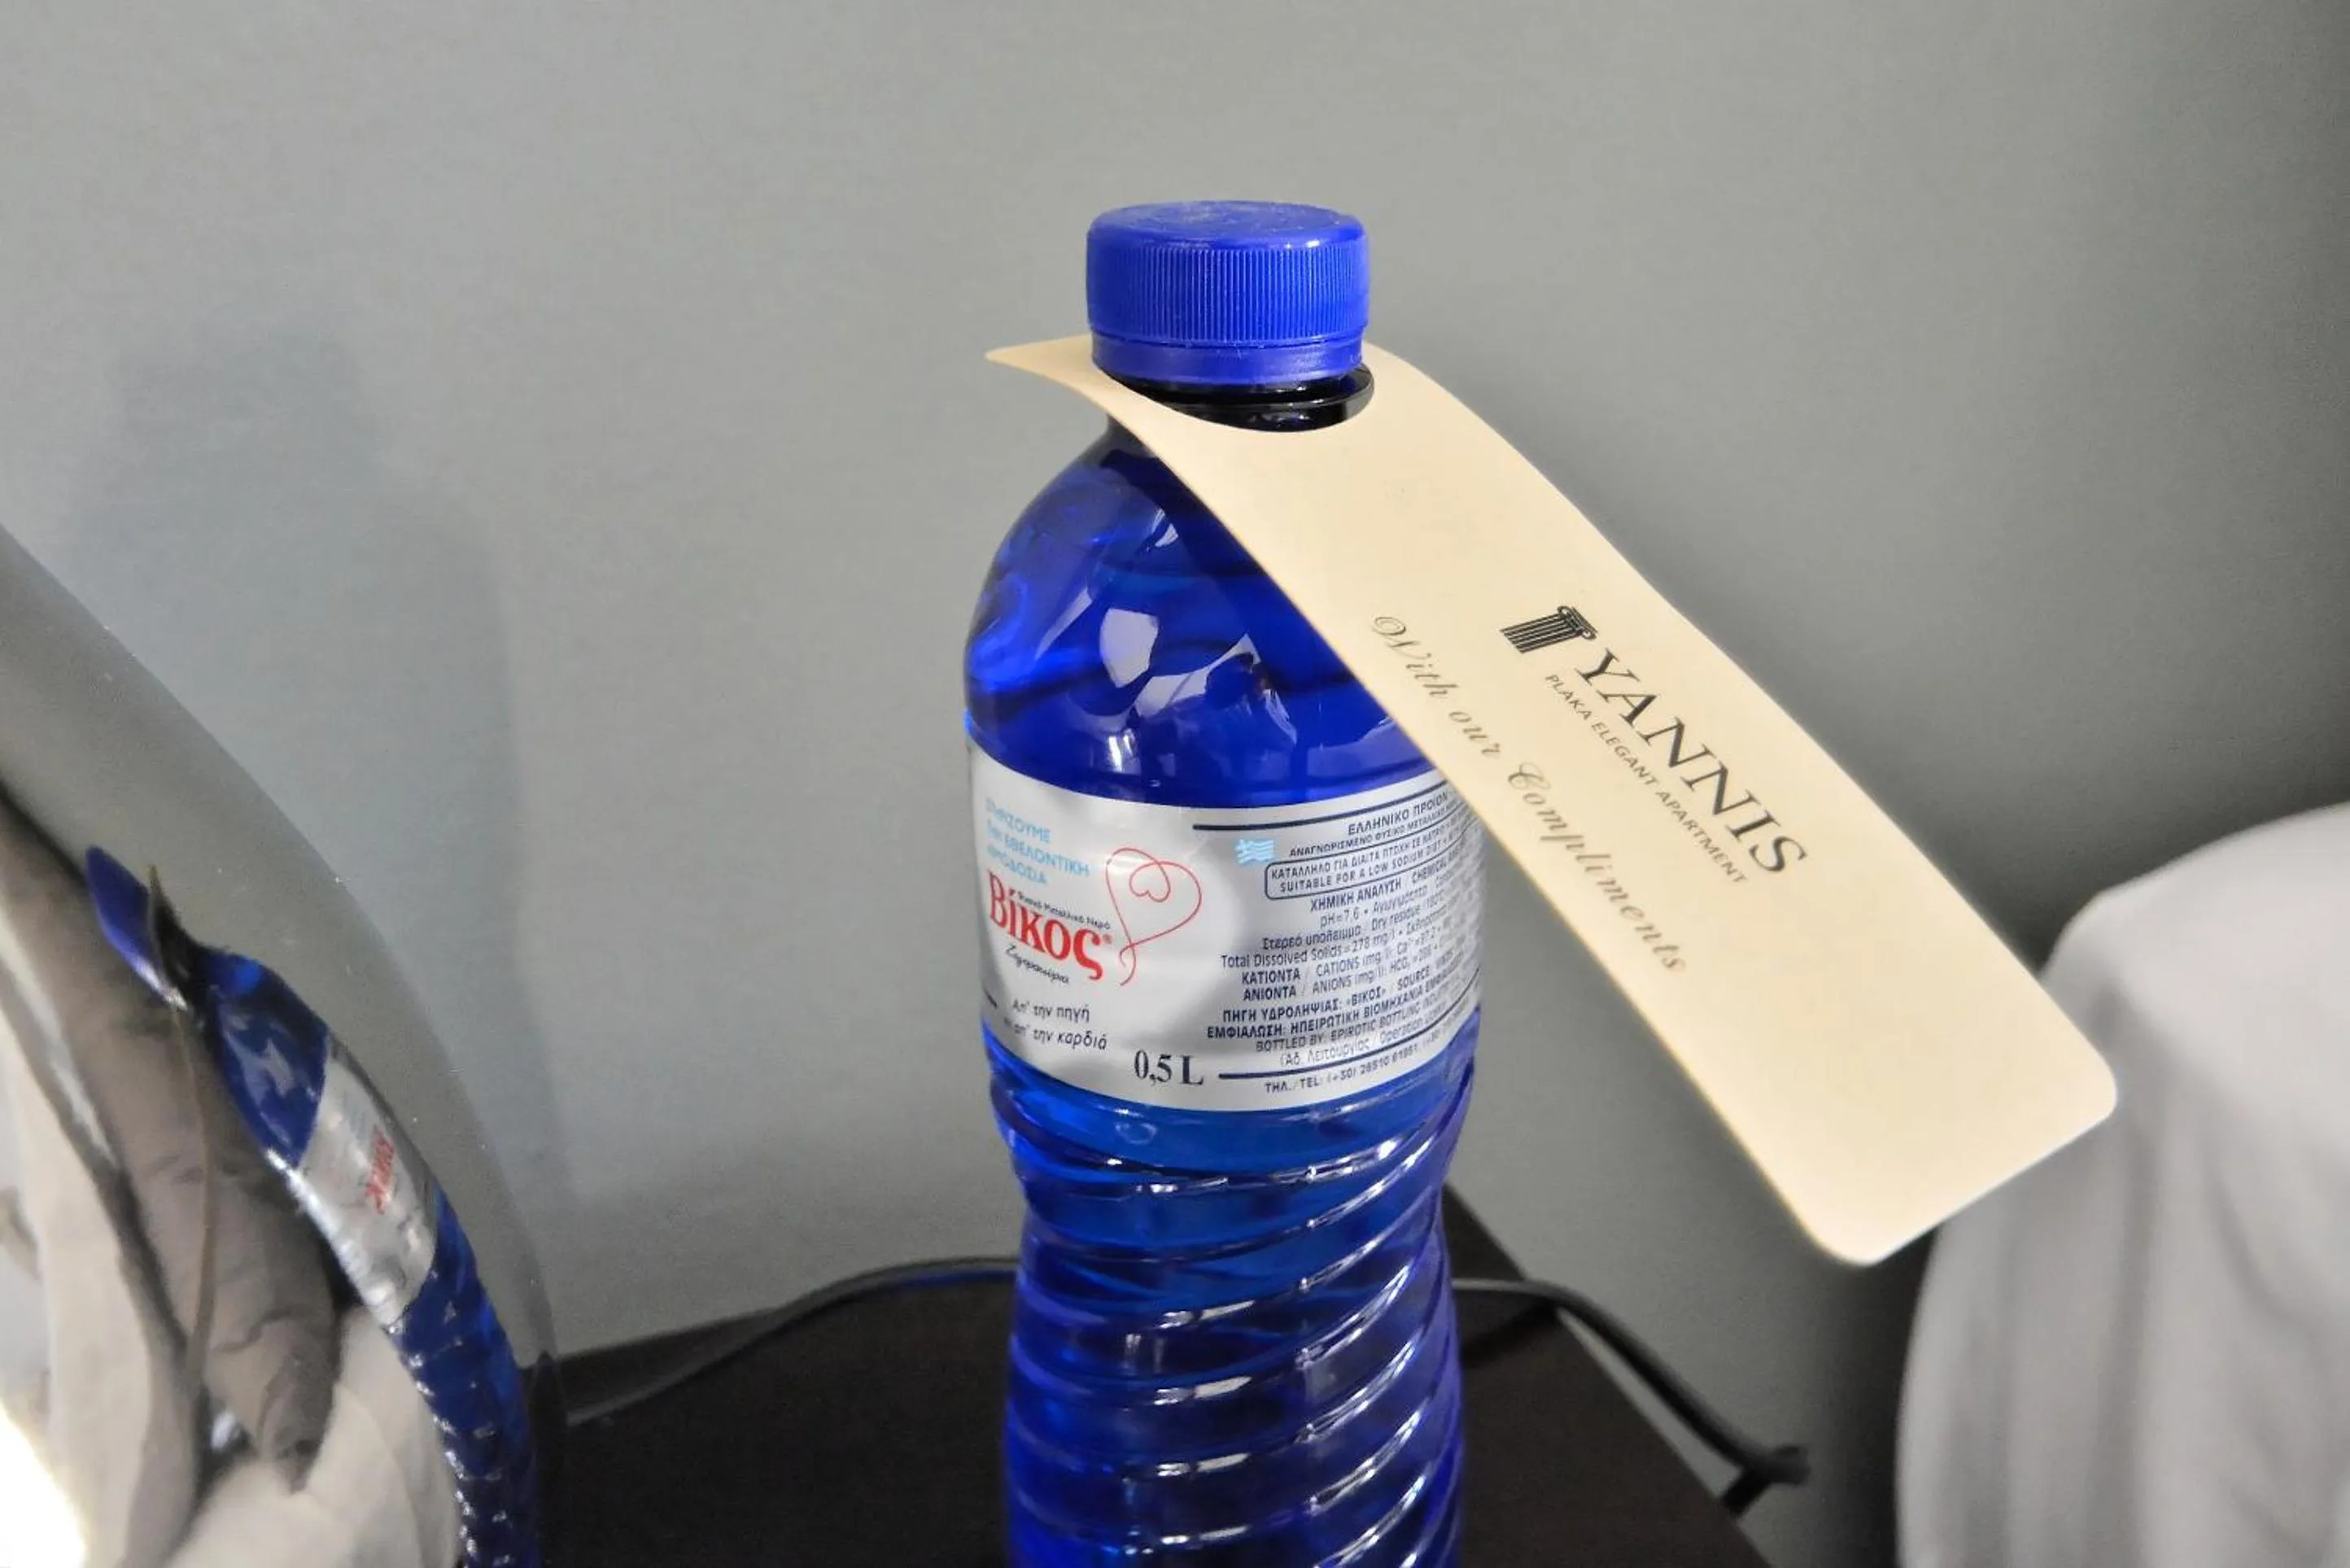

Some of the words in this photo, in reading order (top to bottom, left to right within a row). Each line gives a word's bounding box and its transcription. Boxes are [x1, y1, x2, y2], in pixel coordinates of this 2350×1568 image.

[1574, 648, 1808, 873] YANNIS
[1545, 674, 1592, 720] PLAKA
[1592, 721, 1659, 786] ELEGANT
[1656, 789, 1747, 883] APARTMENT
[1372, 616, 1459, 698] With
[1448, 711, 1501, 757] our
[1507, 762, 1686, 974] Compliments
[1348, 809, 1409, 836] ΕΛΛΗΝΙΚΟ
[1280, 875, 1332, 893] SUITABLE
[1335, 869, 1356, 883] FOR
[1369, 862, 1390, 876] LOW
[1311, 889, 1355, 913] ΧΗΜΙΚΗ
[1221, 953, 1251, 969] Total
[1254, 949, 1308, 967] Dissolved
[1242, 967, 1301, 985] ΚΑΤΙΟΝΤΑ
[1316, 955, 1360, 977] CATIONS
[1243, 985, 1297, 1002] ΑΝΙΟΝΤΑ
[1313, 973, 1352, 994] ANIONS
[1057, 1004, 1090, 1023] πηγή
[1223, 1009, 1256, 1023] ΠΗΓΗ
[1291, 1011, 1360, 1034] ΗΠΕΙΡΩΤΙΚΗ
[1057, 1029, 1107, 1050] καρδιά
[1256, 1037, 1306, 1052] BOTTLED
[1133, 1049, 1173, 1085] 0,5
[1180, 1055, 1204, 1085] L
